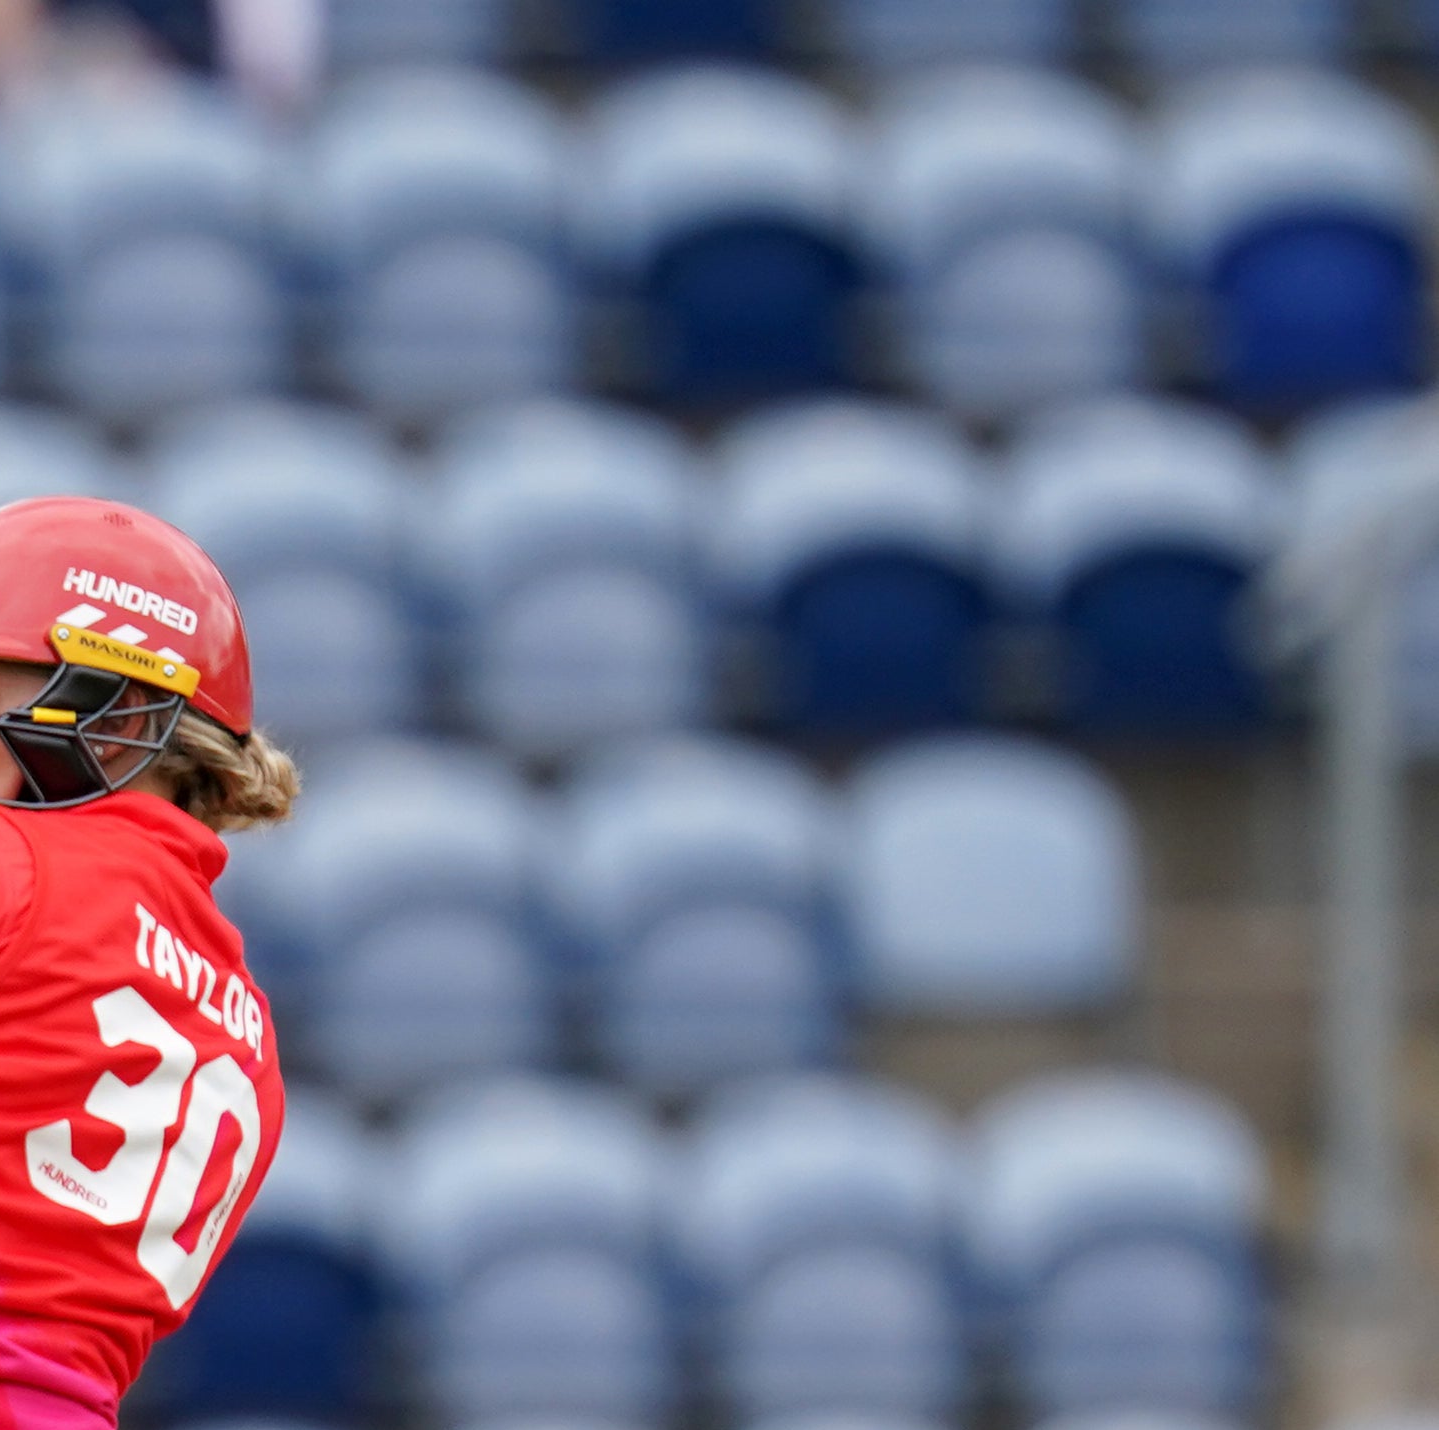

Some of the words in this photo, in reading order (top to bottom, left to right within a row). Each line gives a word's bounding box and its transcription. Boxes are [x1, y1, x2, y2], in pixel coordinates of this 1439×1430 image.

[63, 567, 198, 636] HUNDRED
[79, 635, 157, 670] MASURI
[135, 904, 264, 1062] TAYLOR
[24, 986, 261, 1311] 30
[38, 1160, 109, 1211] HUNDRED
